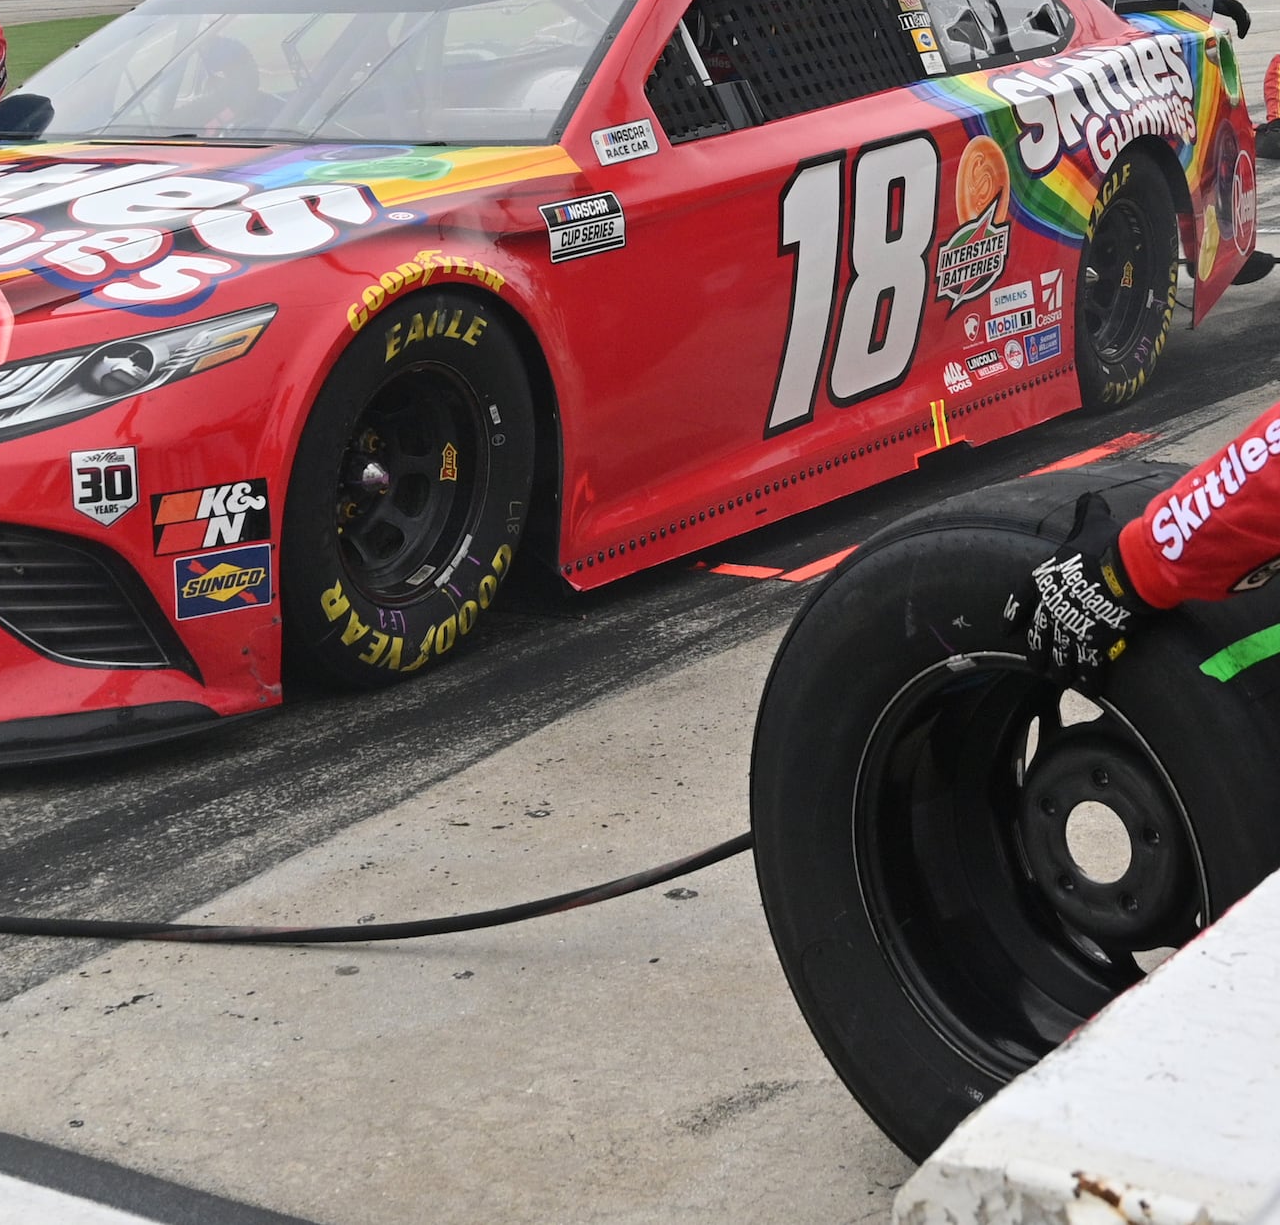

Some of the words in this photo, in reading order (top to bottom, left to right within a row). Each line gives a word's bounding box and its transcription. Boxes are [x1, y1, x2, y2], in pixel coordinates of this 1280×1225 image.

[611, 125, 646, 144] NASCAR
[606, 145, 630, 159] RACE
[631, 140, 650, 153] CAR
[568, 198, 610, 220] NASCAR
[561, 229, 581, 247] CUP
[581, 221, 615, 243] SERIES
[941, 234, 1004, 269] INTERSTATE
[943, 254, 1000, 288] BATTERIES
[347, 250, 505, 331] GOODYEAR
[765, 131, 939, 438] 18
[994, 290, 1028, 307] SIEMENS
[988, 315, 1018, 336] Mobil
[1021, 311, 1032, 326] 1
[966, 350, 998, 371] LINCOLN
[943, 362, 969, 387] MAC
[947, 379, 973, 394] TOOLS
[77, 464, 133, 504] 30
[94, 503, 119, 515] YEARS
[185, 567, 265, 599] SUNOCO
